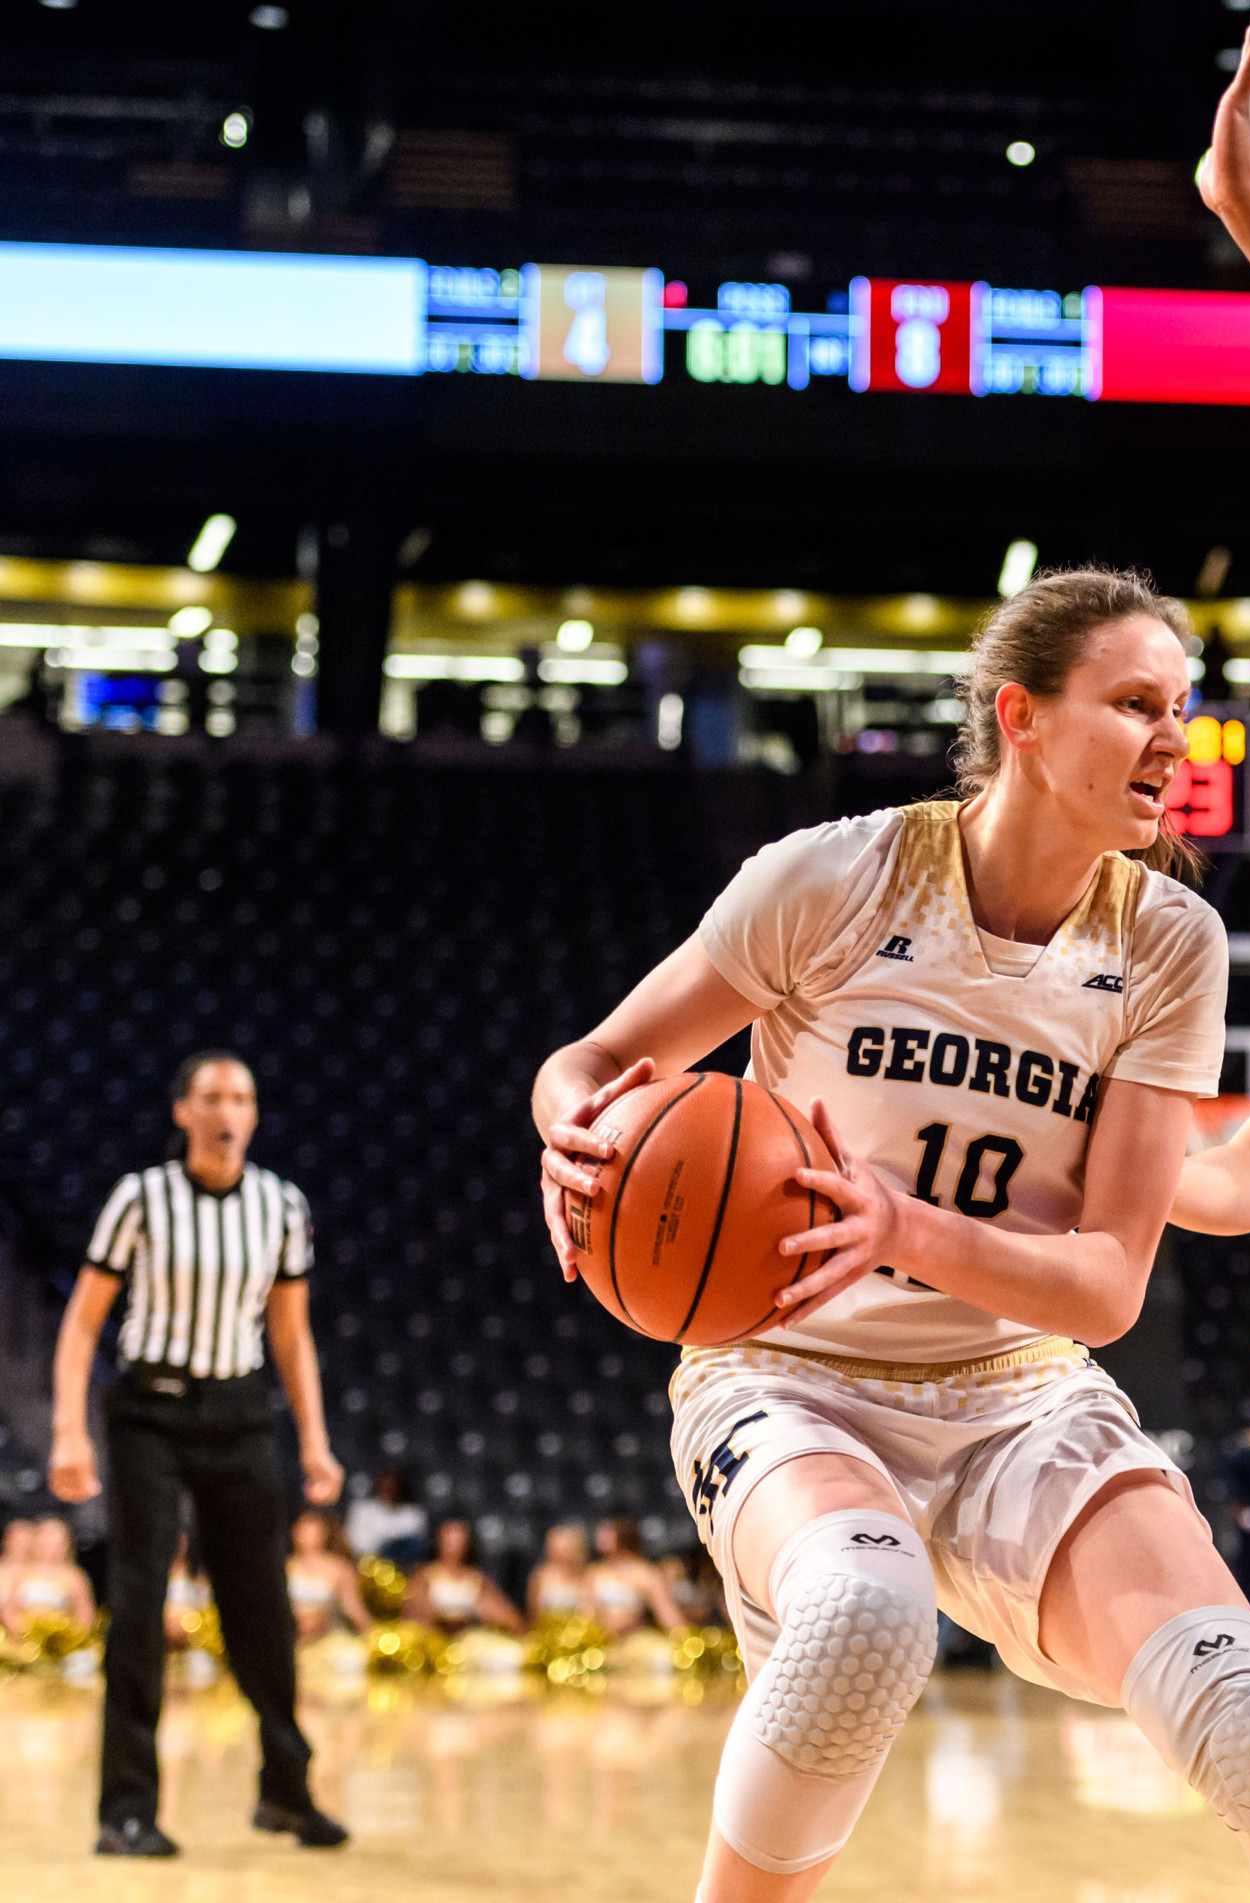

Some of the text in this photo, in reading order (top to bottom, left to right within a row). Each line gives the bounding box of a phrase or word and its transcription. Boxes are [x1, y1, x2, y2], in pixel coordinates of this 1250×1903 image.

[1081, 973, 1123, 994] ACC
[846, 1025, 1100, 1126] GEORGIA
[907, 1120, 1027, 1219] 10
